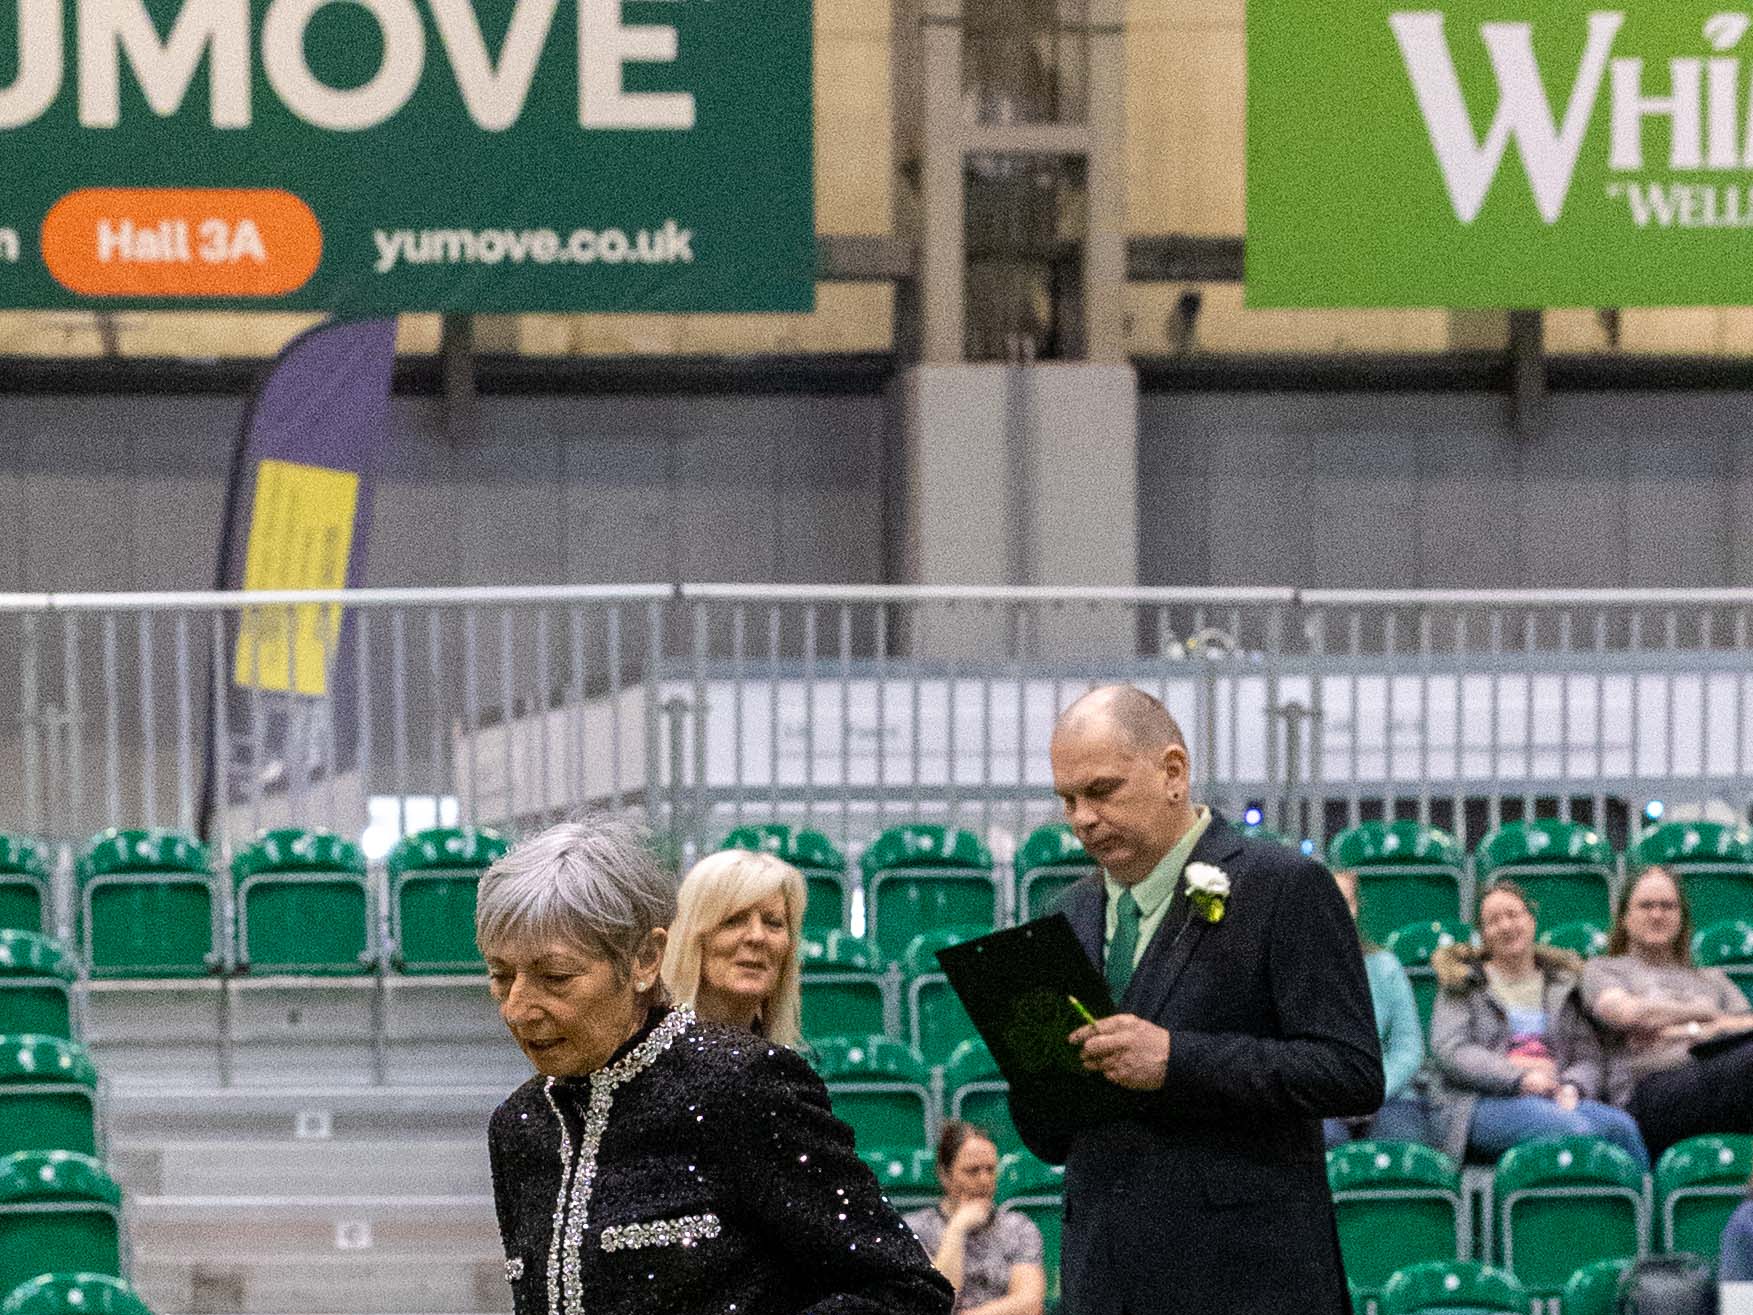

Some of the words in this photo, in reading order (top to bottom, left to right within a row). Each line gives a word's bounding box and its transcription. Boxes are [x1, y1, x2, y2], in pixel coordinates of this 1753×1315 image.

[1389, 12, 1753, 225] WHI
[97, 219, 191, 264] Hall
[198, 219, 267, 264] 3A
[374, 218, 695, 273] yumove.co.uk
